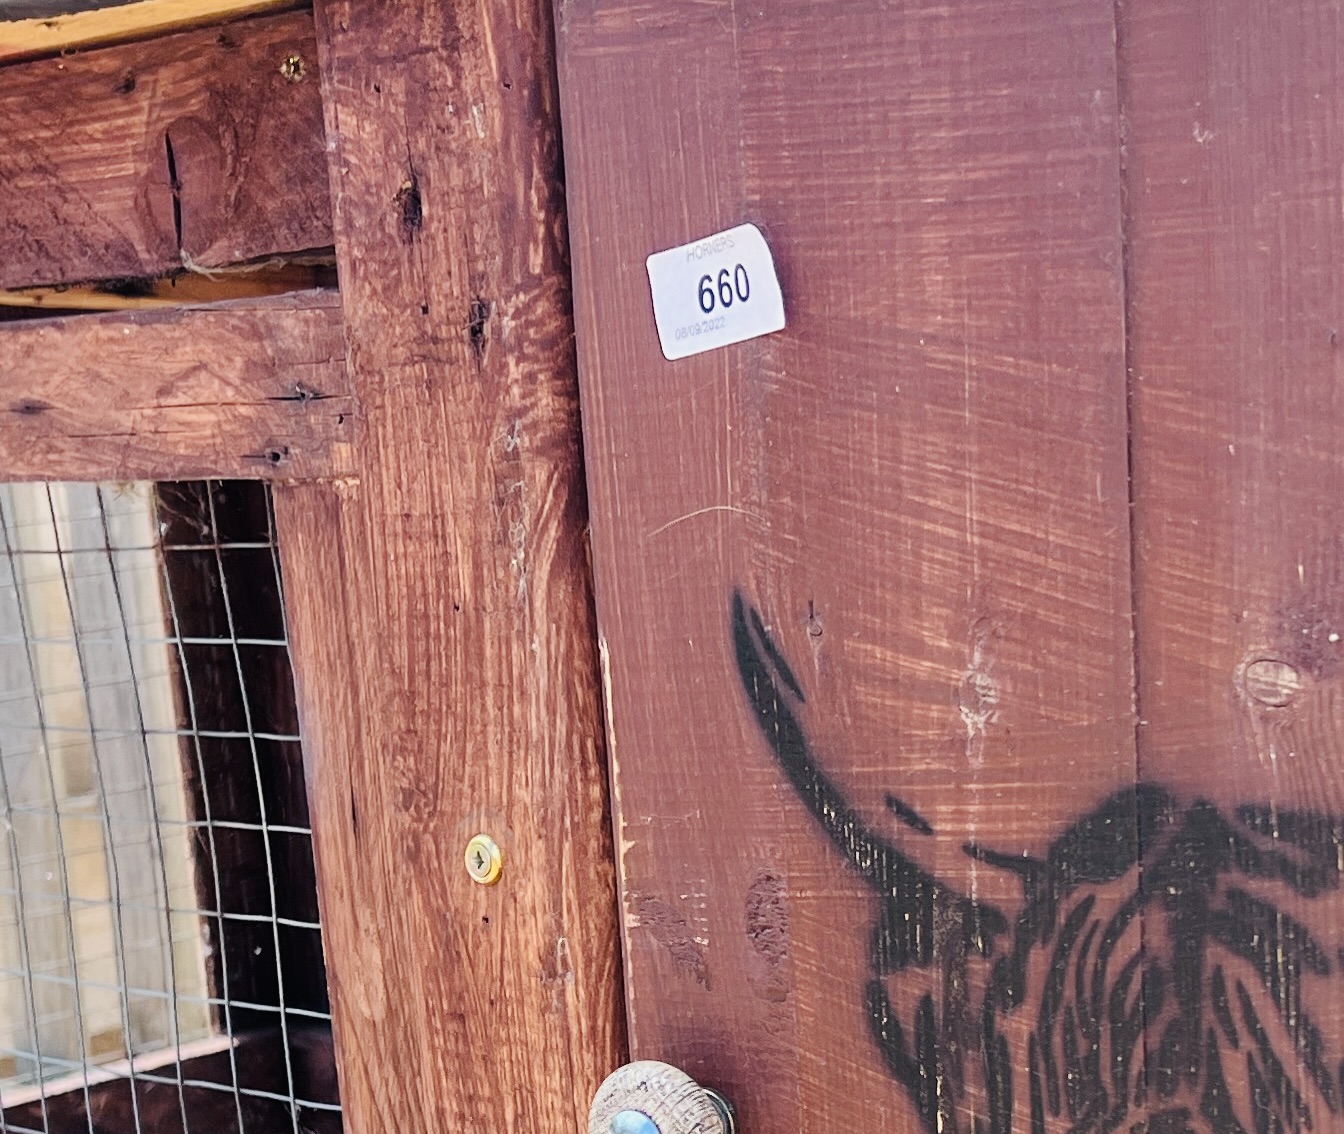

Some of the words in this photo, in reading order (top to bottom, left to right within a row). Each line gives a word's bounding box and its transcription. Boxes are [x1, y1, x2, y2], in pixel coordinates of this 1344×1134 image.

[686, 234, 735, 262] HORNERS
[698, 263, 750, 314] 660
[674, 316, 726, 340] 08/09/2022
